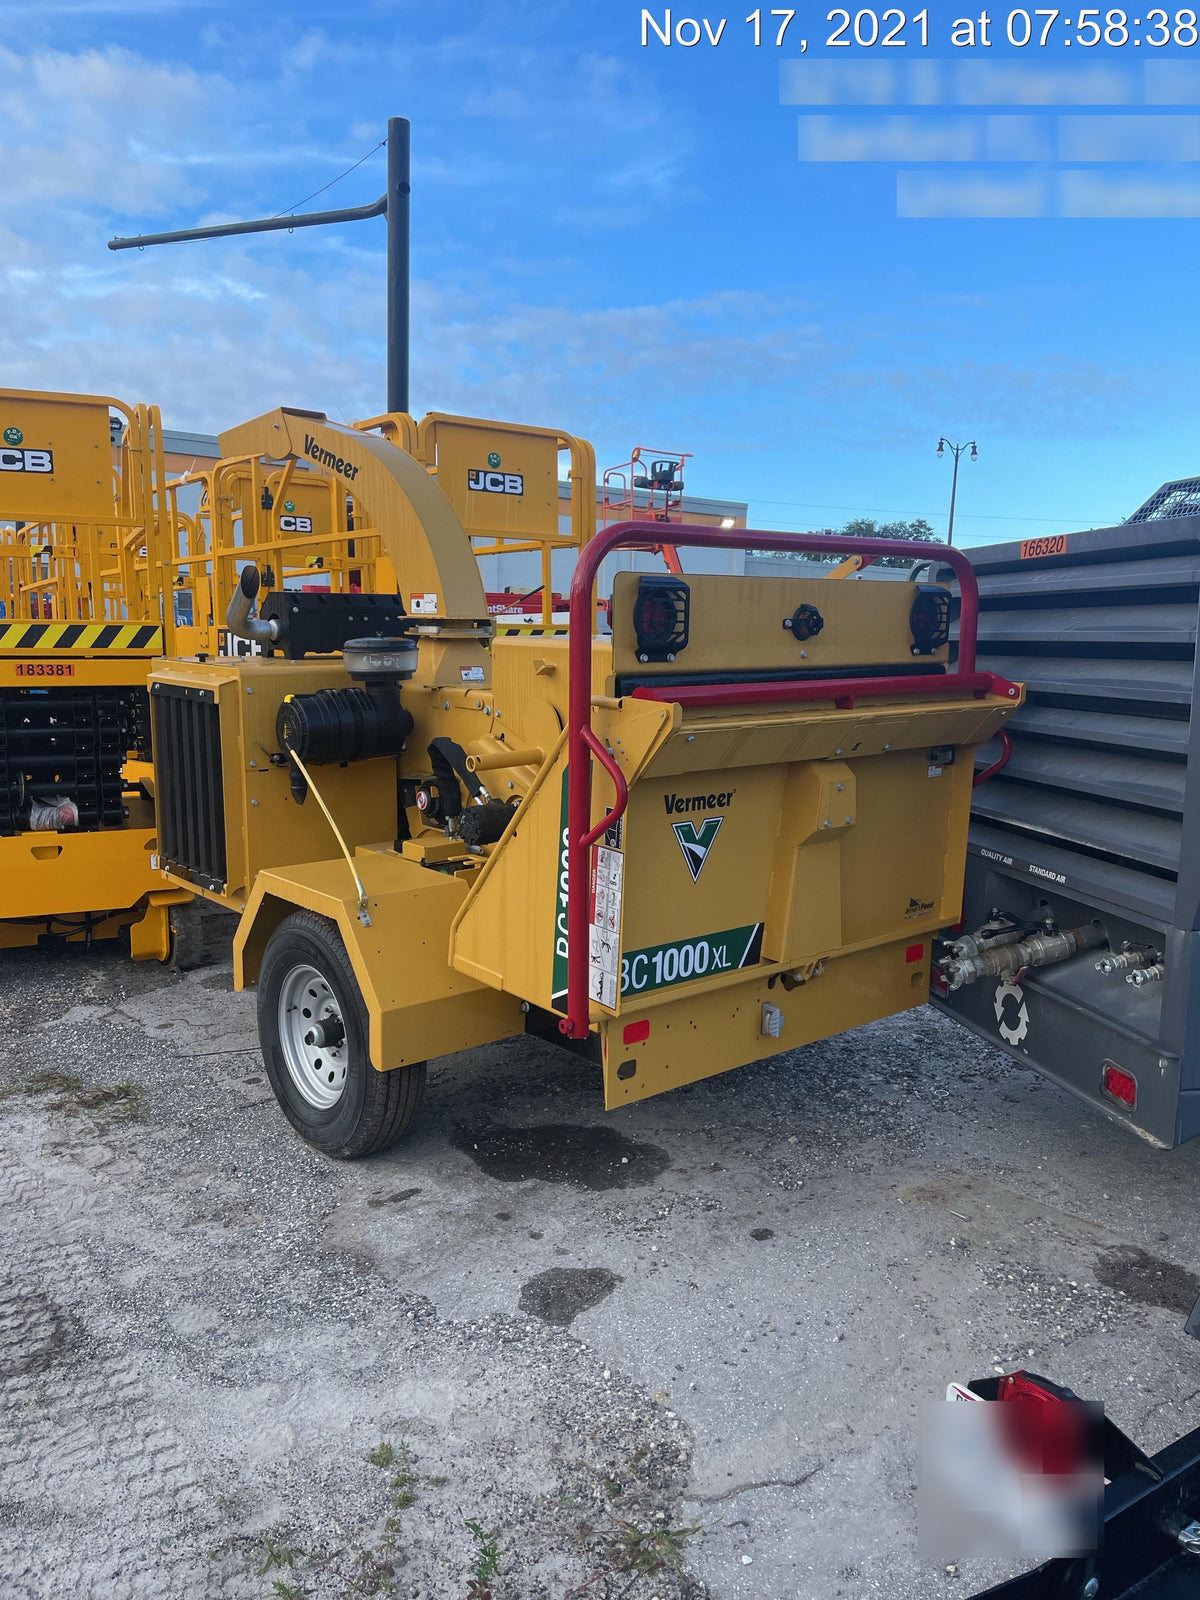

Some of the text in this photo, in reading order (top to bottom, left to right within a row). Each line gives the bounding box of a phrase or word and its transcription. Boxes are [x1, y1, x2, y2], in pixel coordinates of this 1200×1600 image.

[305, 434, 359, 480] Vermeer
[469, 471, 523, 494] JCB
[1023, 536, 1064, 557] 166320
[17, 664, 72, 676] 183381
[664, 792, 733, 814] Vermeer
[980, 848, 1013, 865] QUALITY AIR
[1028, 864, 1066, 883] STANDARD AIR
